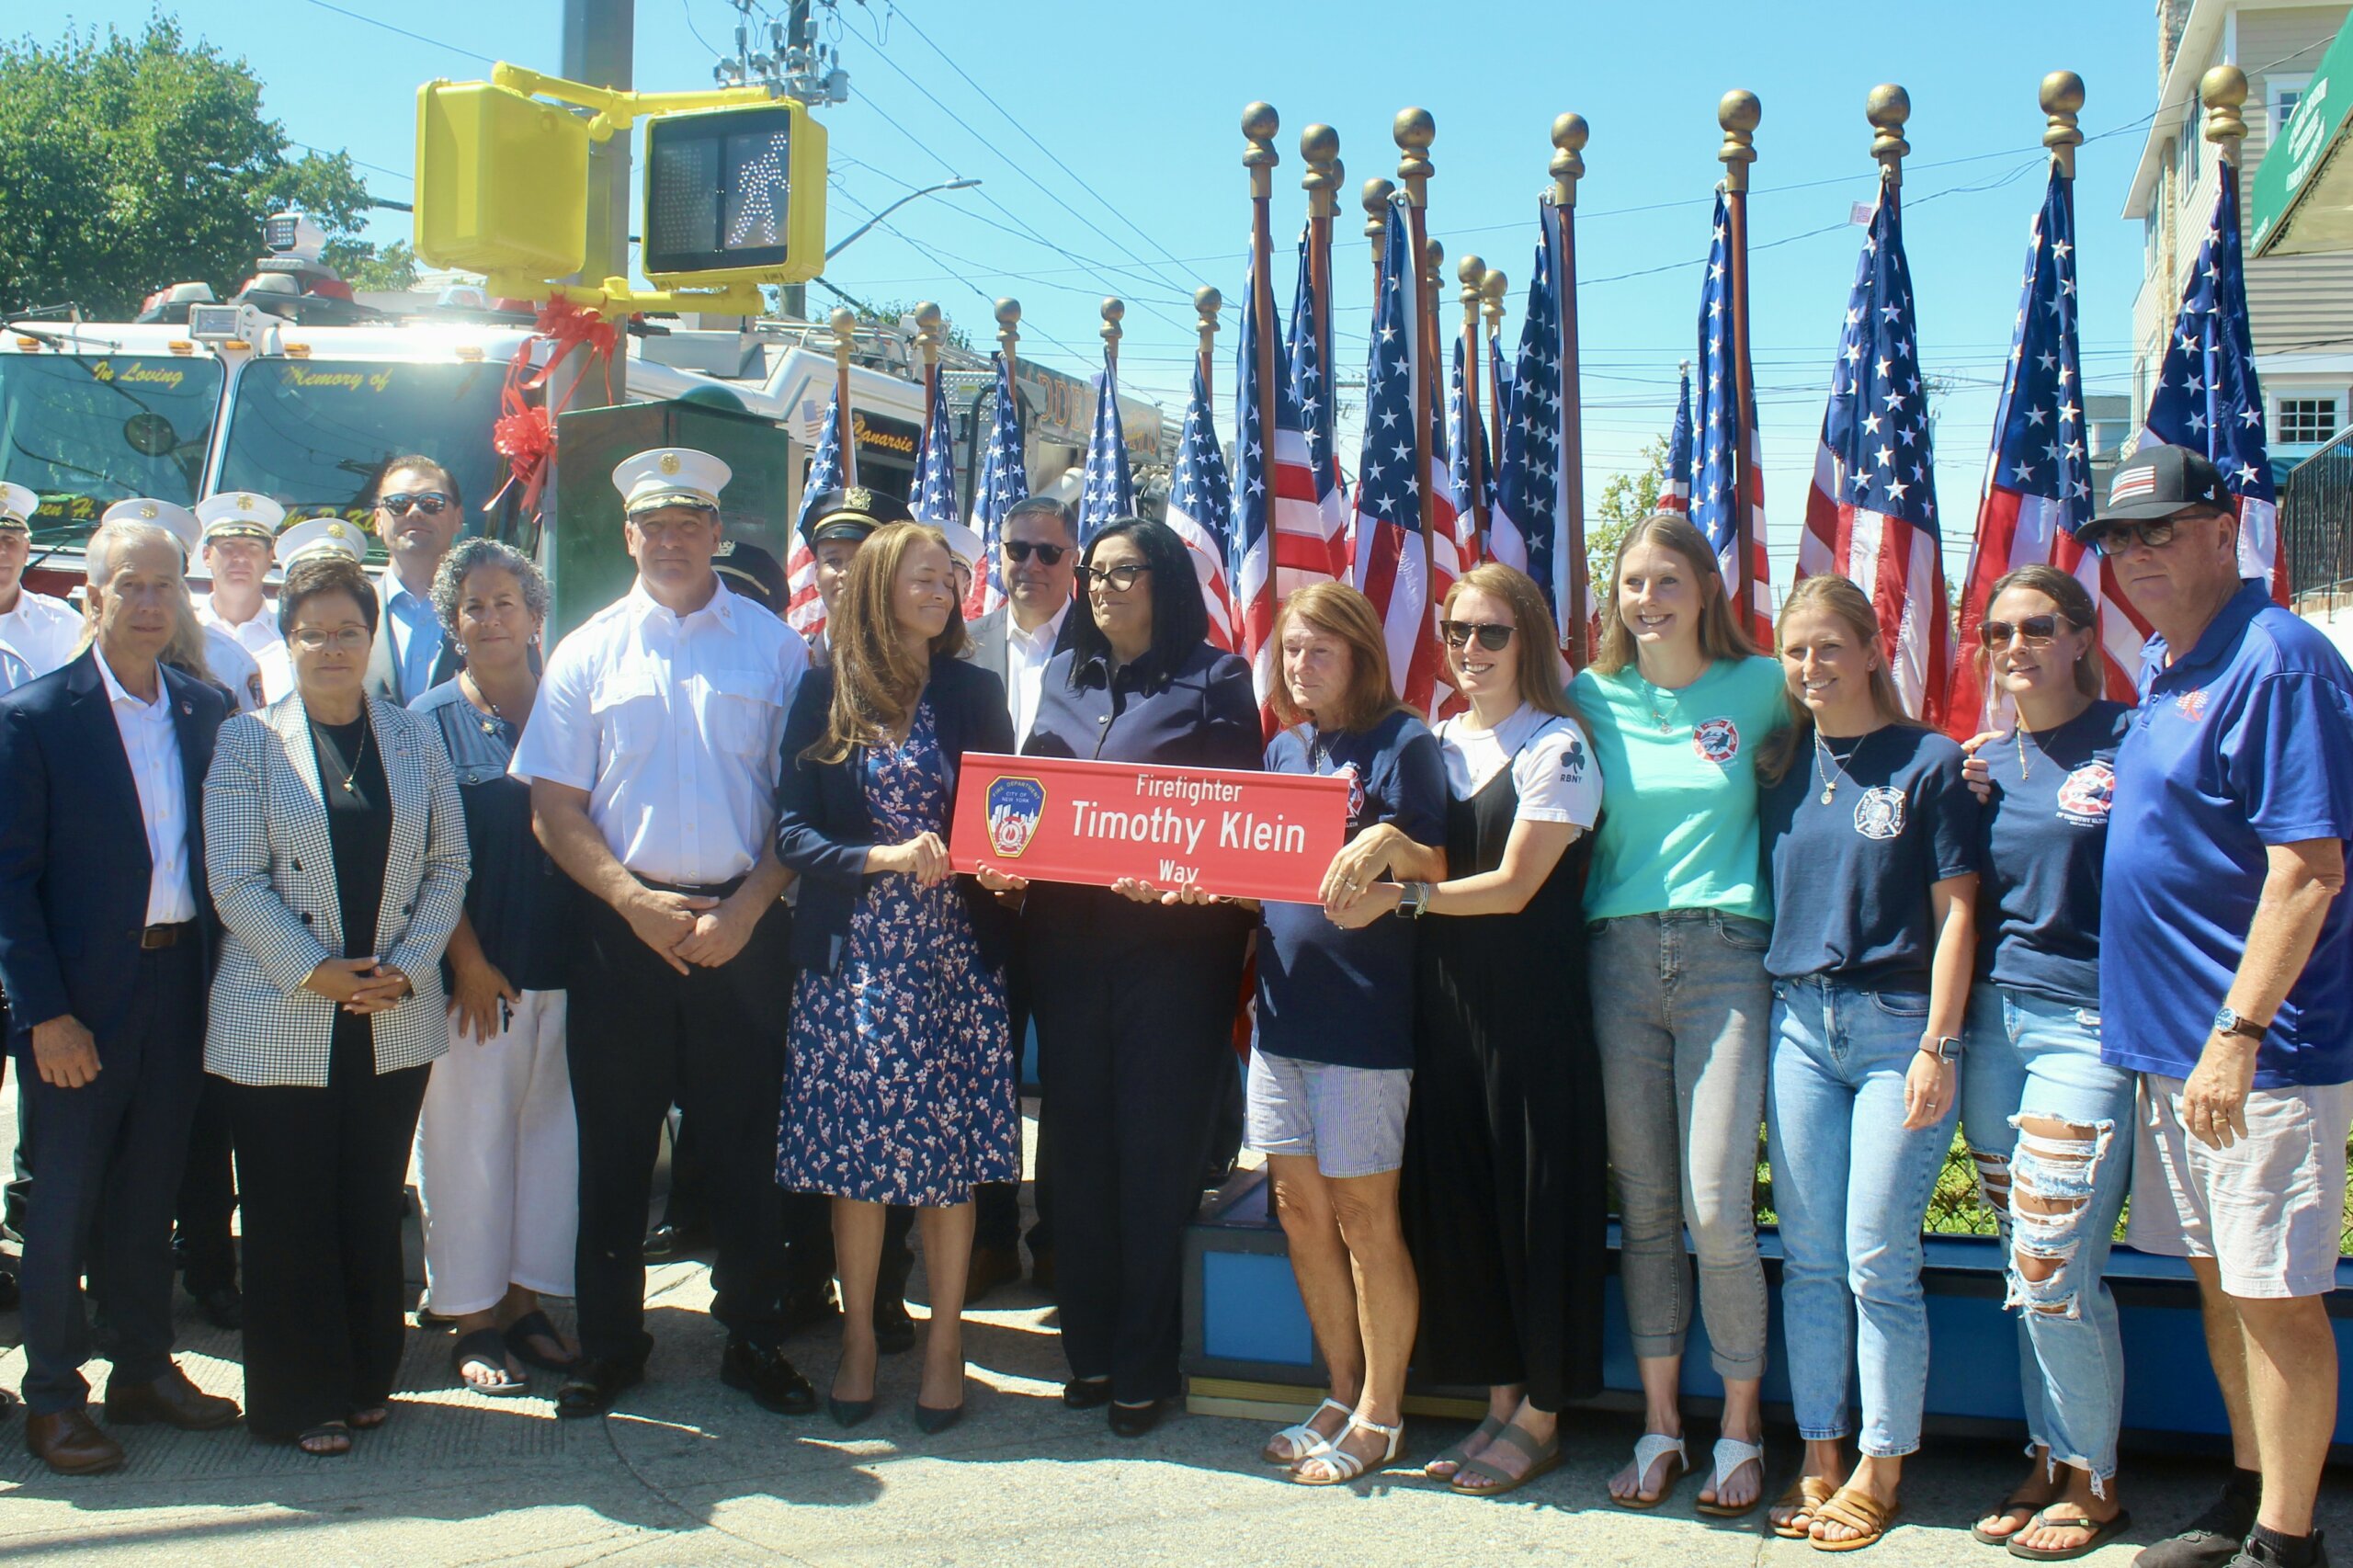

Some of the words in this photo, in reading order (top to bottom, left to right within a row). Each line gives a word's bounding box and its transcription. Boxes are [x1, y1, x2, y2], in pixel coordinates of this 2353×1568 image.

[94, 361, 114, 381] In
[120, 362, 183, 390] Loving
[281, 366, 363, 392] Memory
[369, 368, 393, 392] of
[853, 418, 913, 453] Canarsie
[993, 785, 1005, 798] FIRE
[1006, 780, 1040, 800] DEPARTMENT
[1136, 774, 1243, 806] Firefighter
[1072, 800, 1206, 854] Timothy
[1219, 811, 1305, 853] Klein
[1158, 858, 1199, 882] Way
